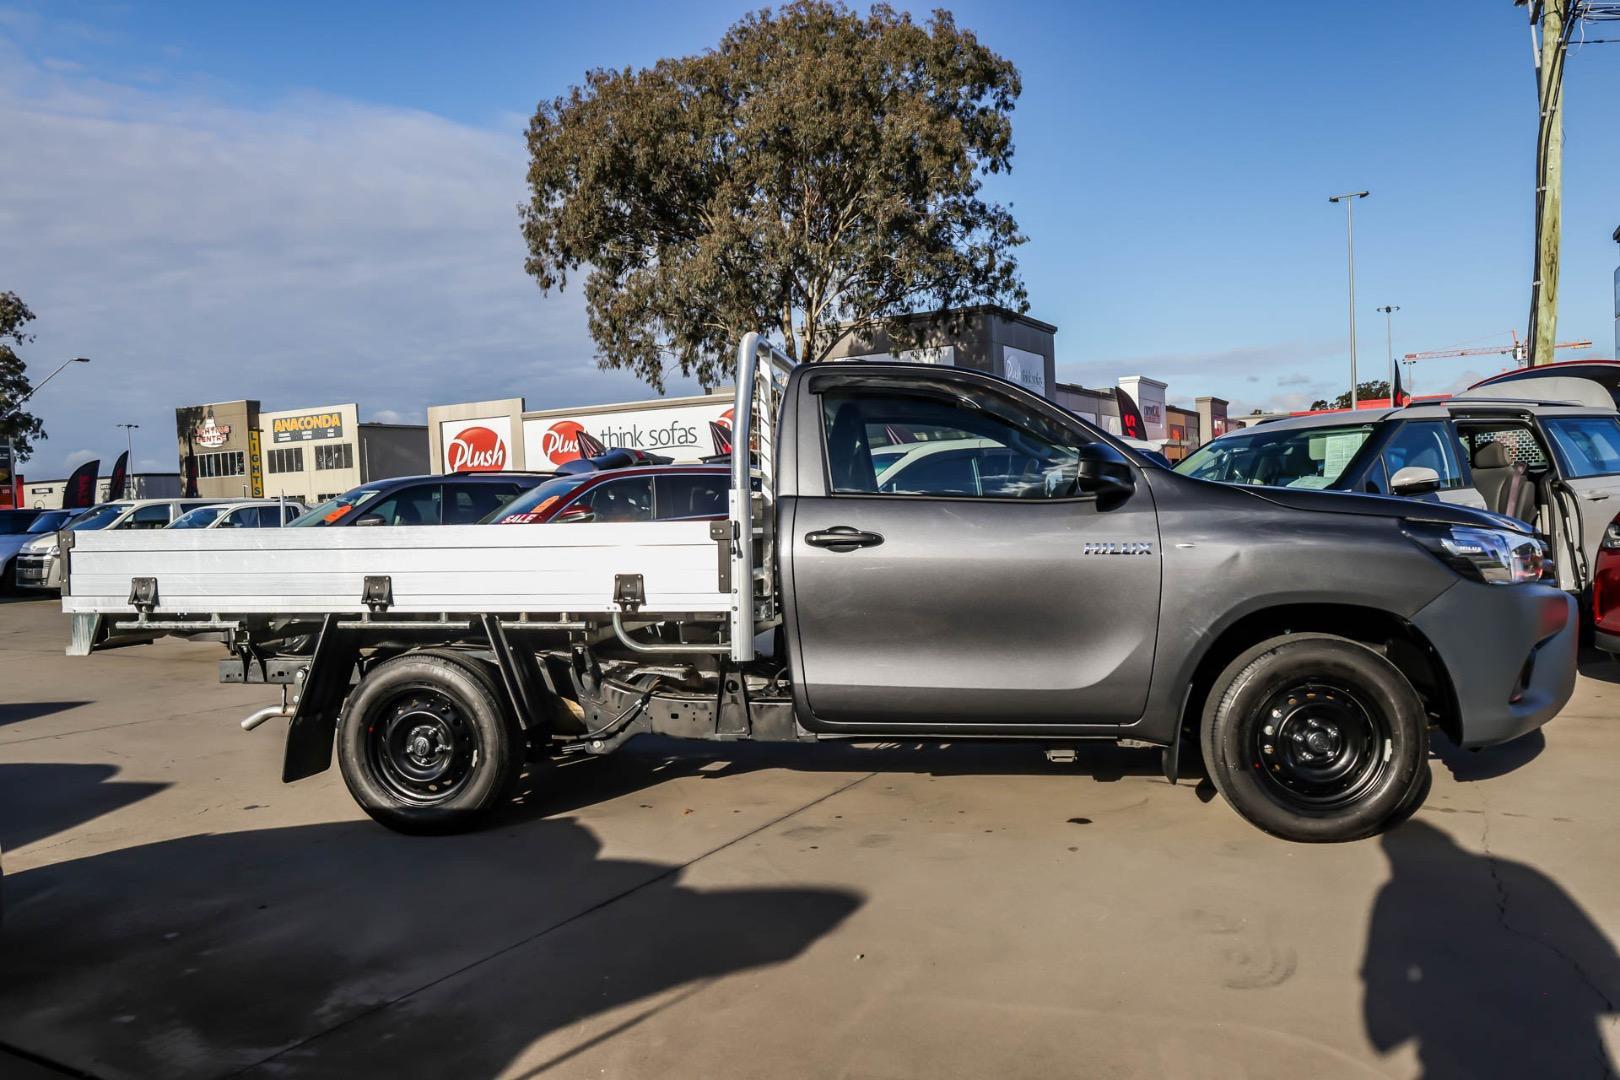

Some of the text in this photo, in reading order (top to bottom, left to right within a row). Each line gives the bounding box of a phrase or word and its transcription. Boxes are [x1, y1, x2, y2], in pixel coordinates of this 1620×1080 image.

[274, 413, 341, 432] ANACONDA
[448, 433, 504, 472] Plush
[545, 420, 698, 457] Plus think sofas
[250, 431, 262, 497] LIGHTS
[501, 513, 539, 523] SALE
[1084, 542, 1153, 555] HILUX
